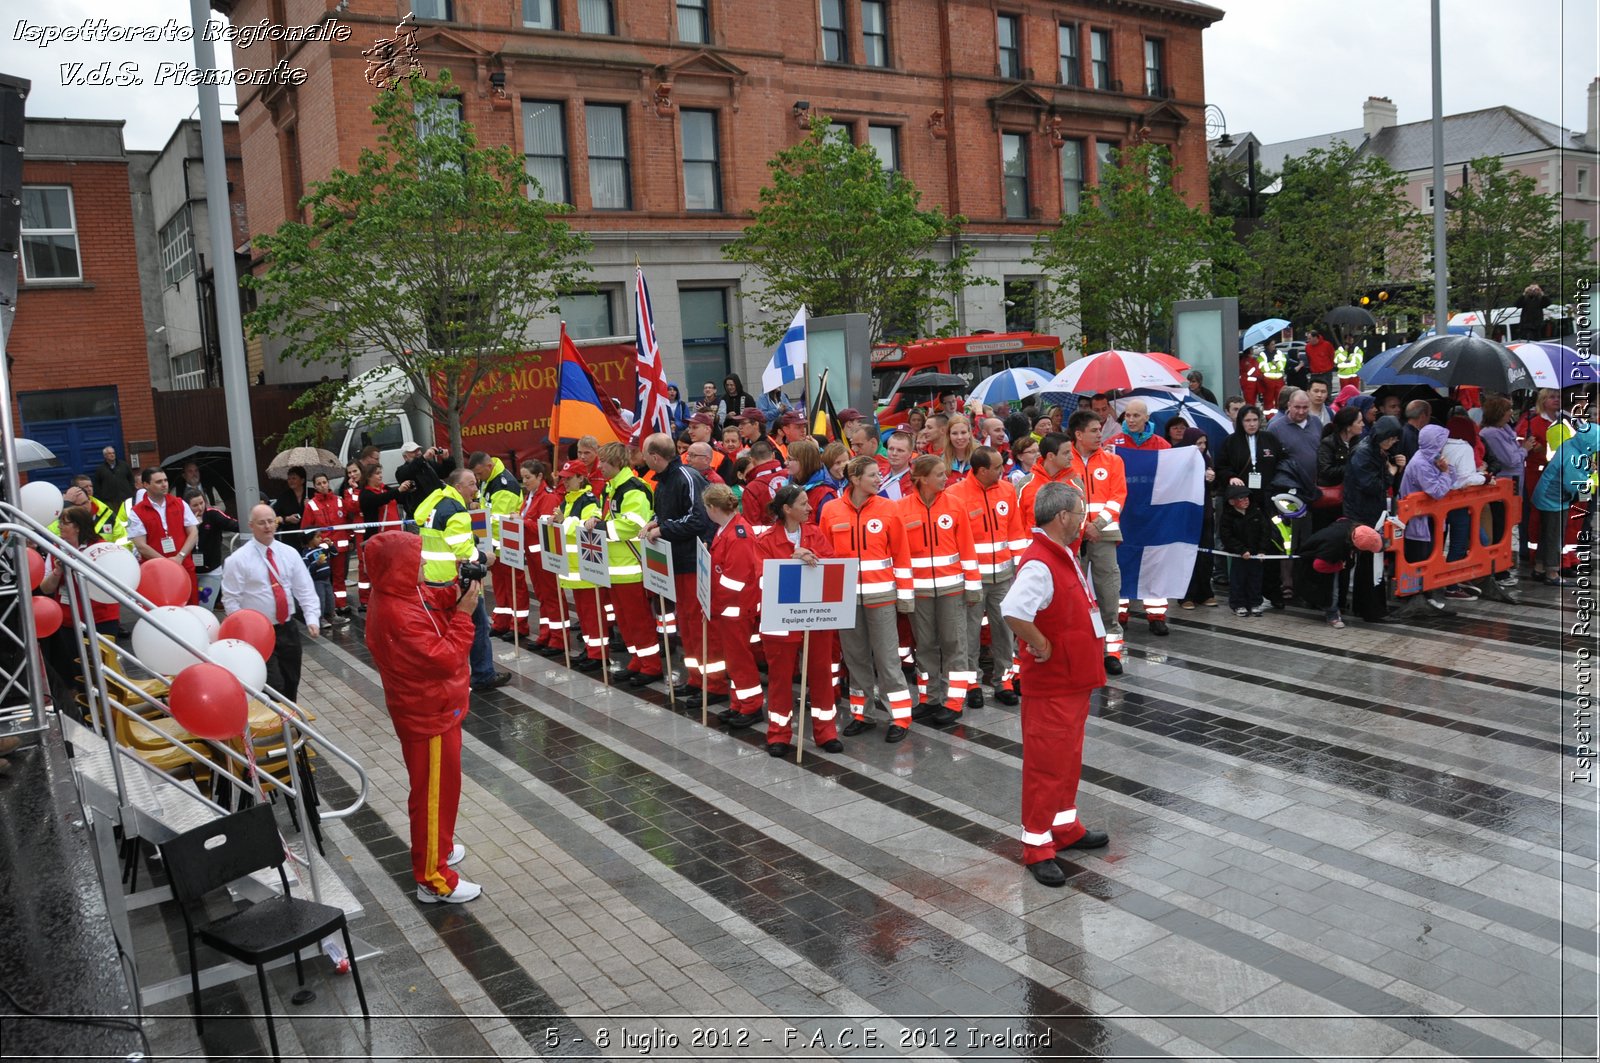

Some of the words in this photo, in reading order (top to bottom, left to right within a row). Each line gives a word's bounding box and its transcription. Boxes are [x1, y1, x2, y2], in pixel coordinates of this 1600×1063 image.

[1412, 356, 1450, 370] Bass
[511, 357, 630, 390] MORRTY
[461, 419, 529, 437] RANSPORT
[781, 617, 805, 625] Equipe
[816, 615, 838, 623] France
